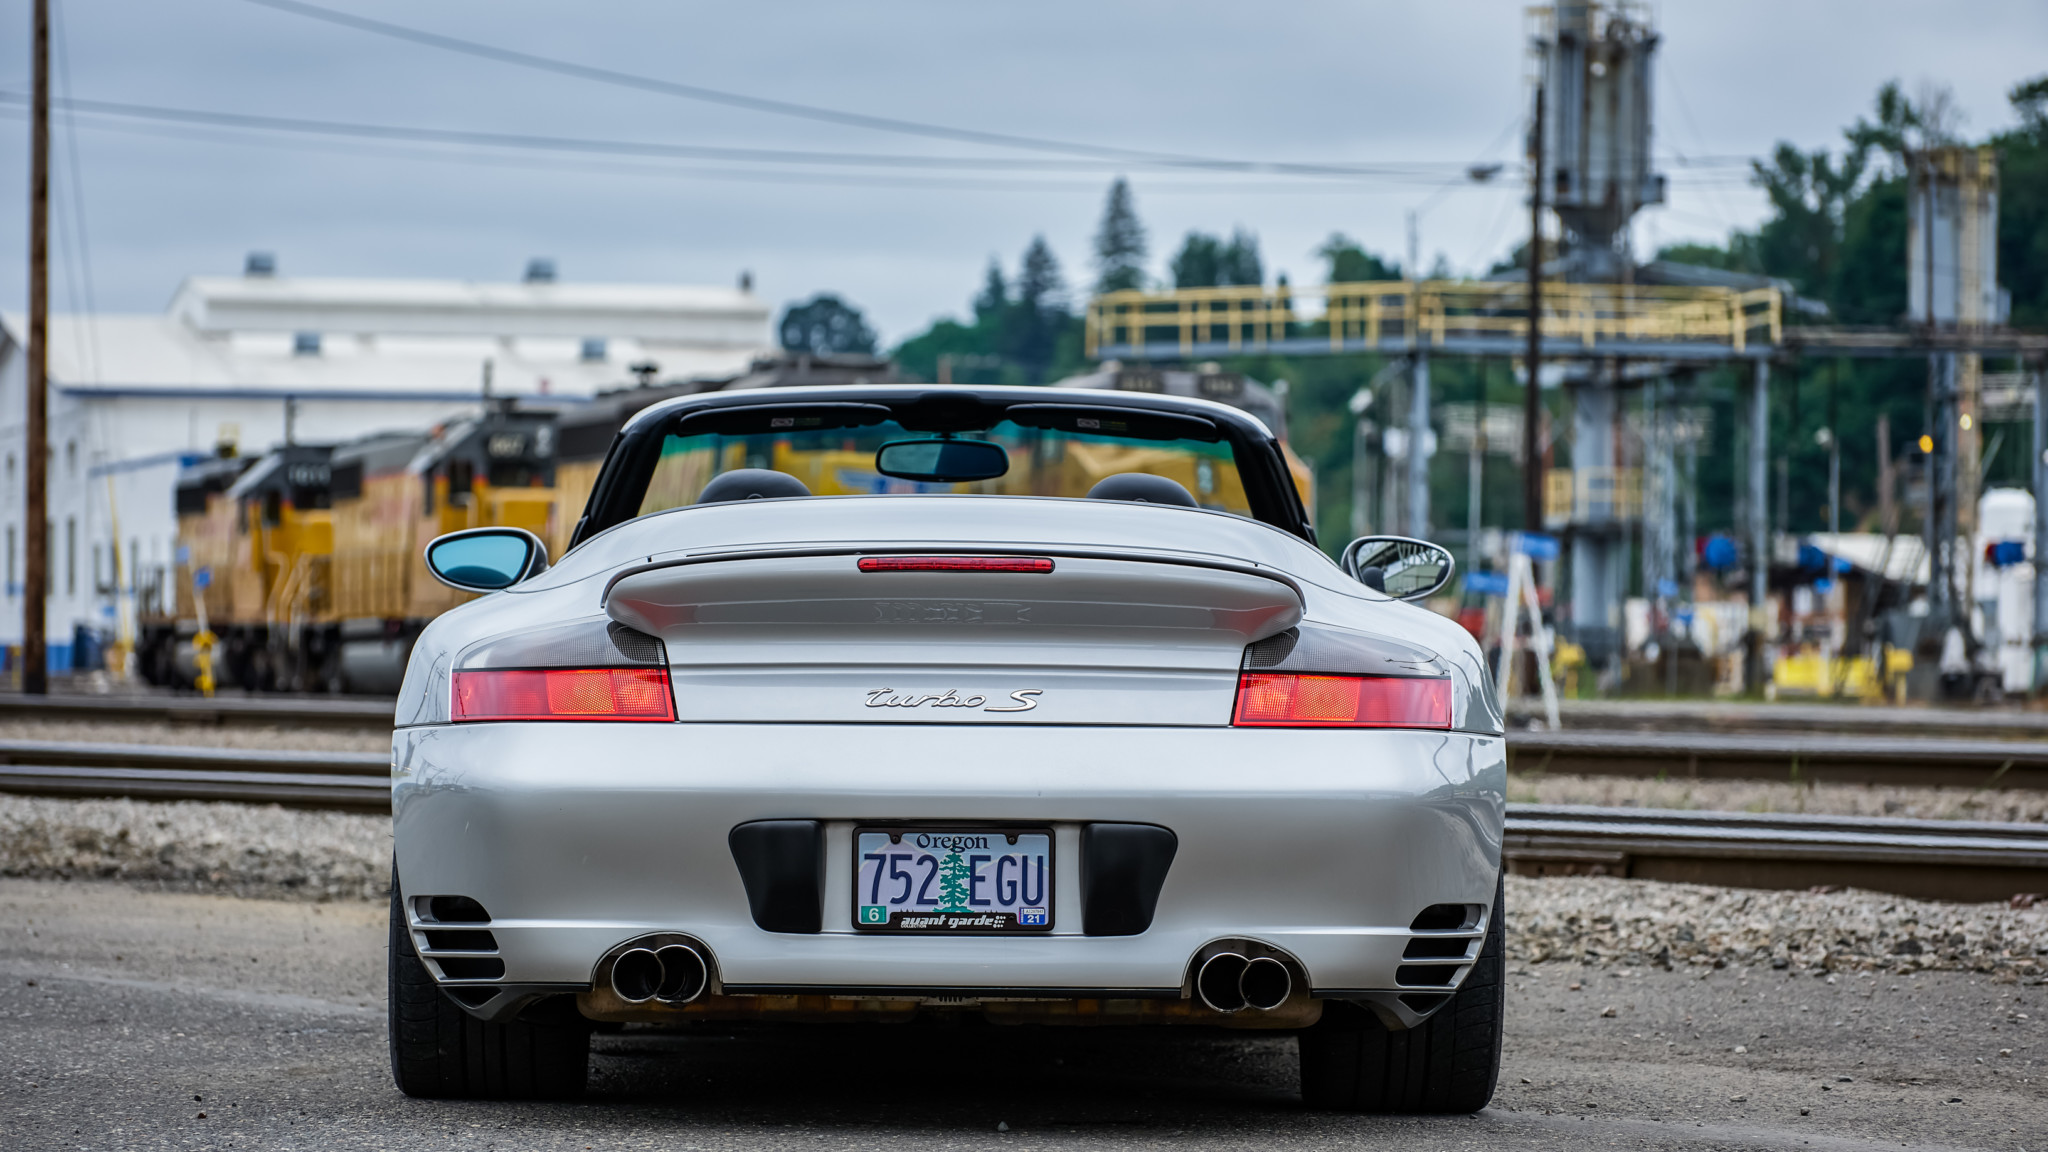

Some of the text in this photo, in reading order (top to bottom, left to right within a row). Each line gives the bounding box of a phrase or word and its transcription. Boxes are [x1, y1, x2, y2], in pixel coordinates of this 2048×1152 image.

[865, 687, 1043, 712] turbo S
[916, 833, 990, 853] Oregon
[864, 853, 1044, 906] 752 EGU
[868, 907, 880, 922] 6
[901, 914, 994, 928] avant garde
[1027, 914, 1040, 923] 21
